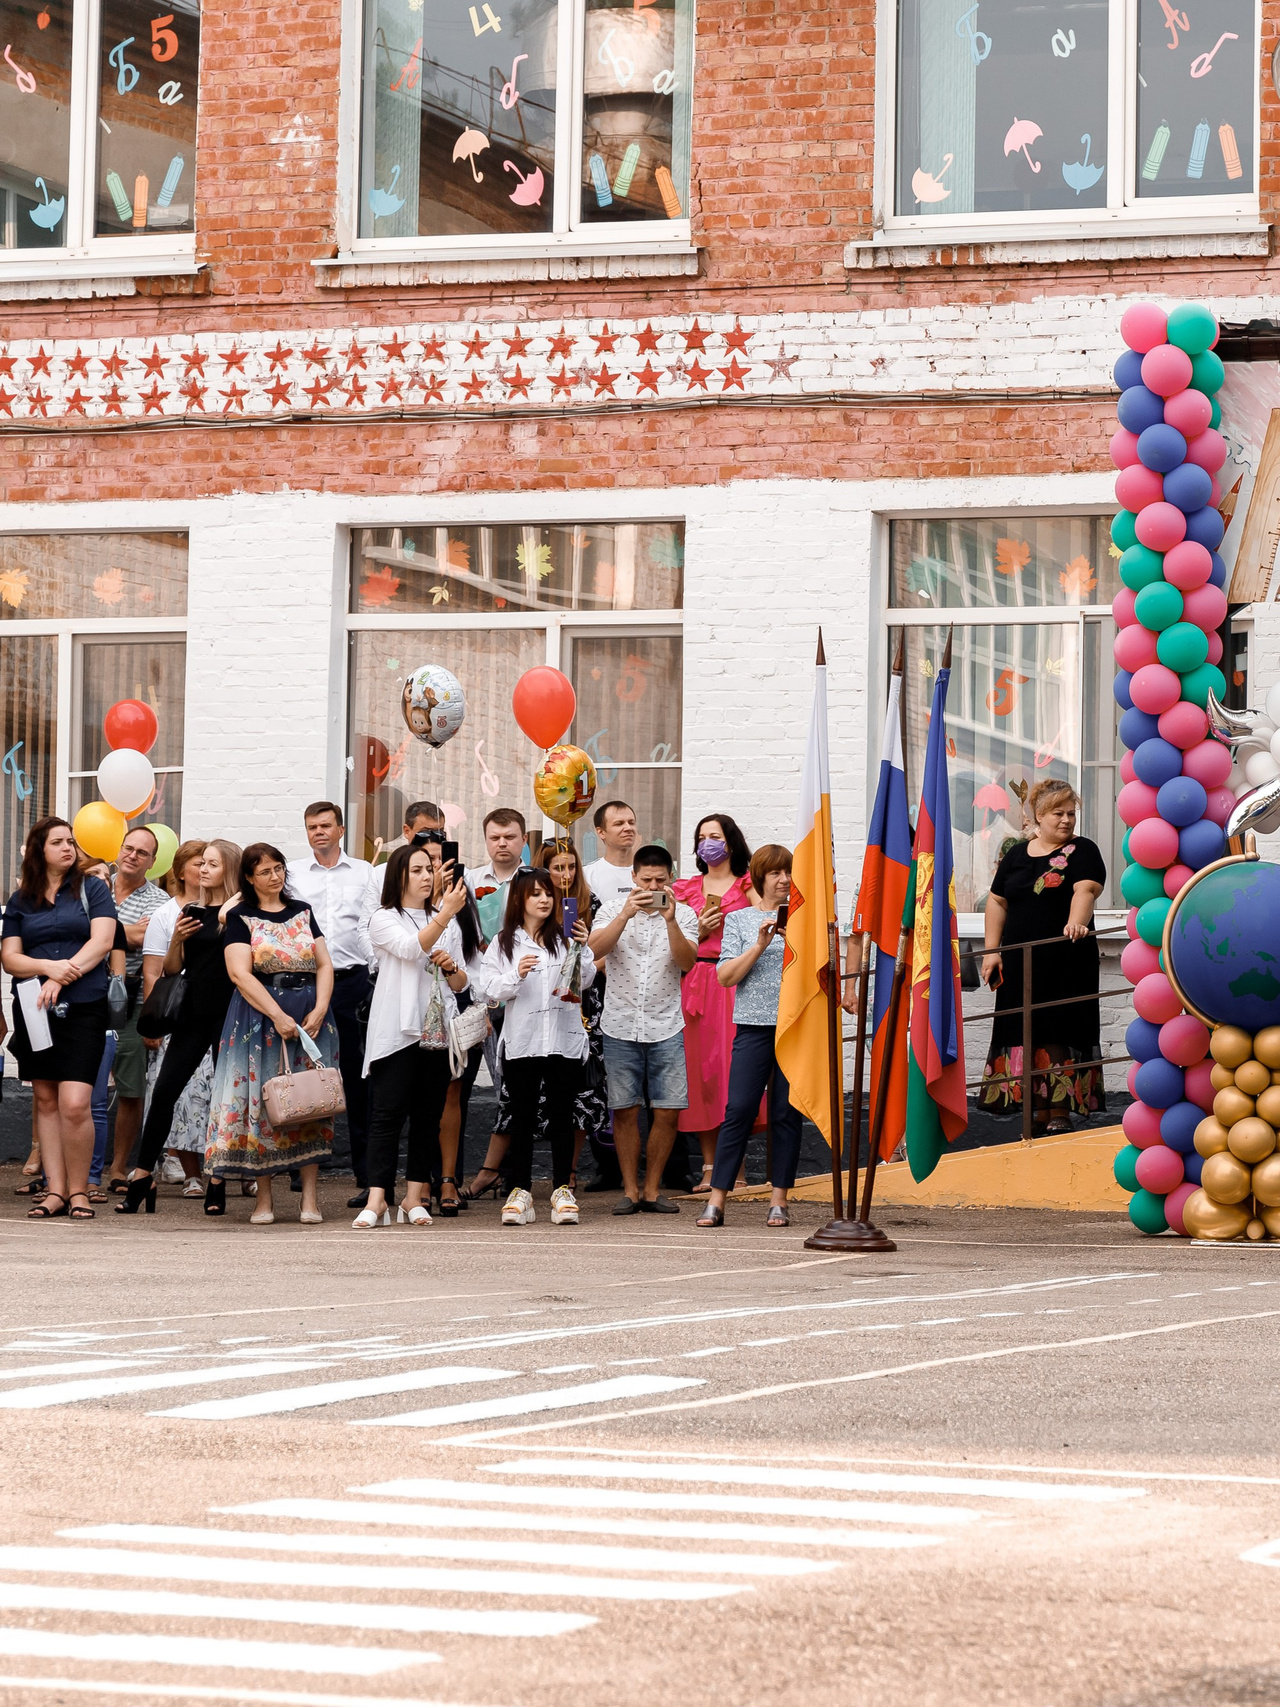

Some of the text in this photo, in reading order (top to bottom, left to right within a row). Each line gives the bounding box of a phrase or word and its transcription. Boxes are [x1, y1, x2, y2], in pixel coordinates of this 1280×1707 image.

[150, 14, 179, 62] 5
[468, 2, 502, 37] 4
[615, 654, 651, 702] 5
[985, 664, 1030, 717] 5
[579, 770, 589, 796] 1
